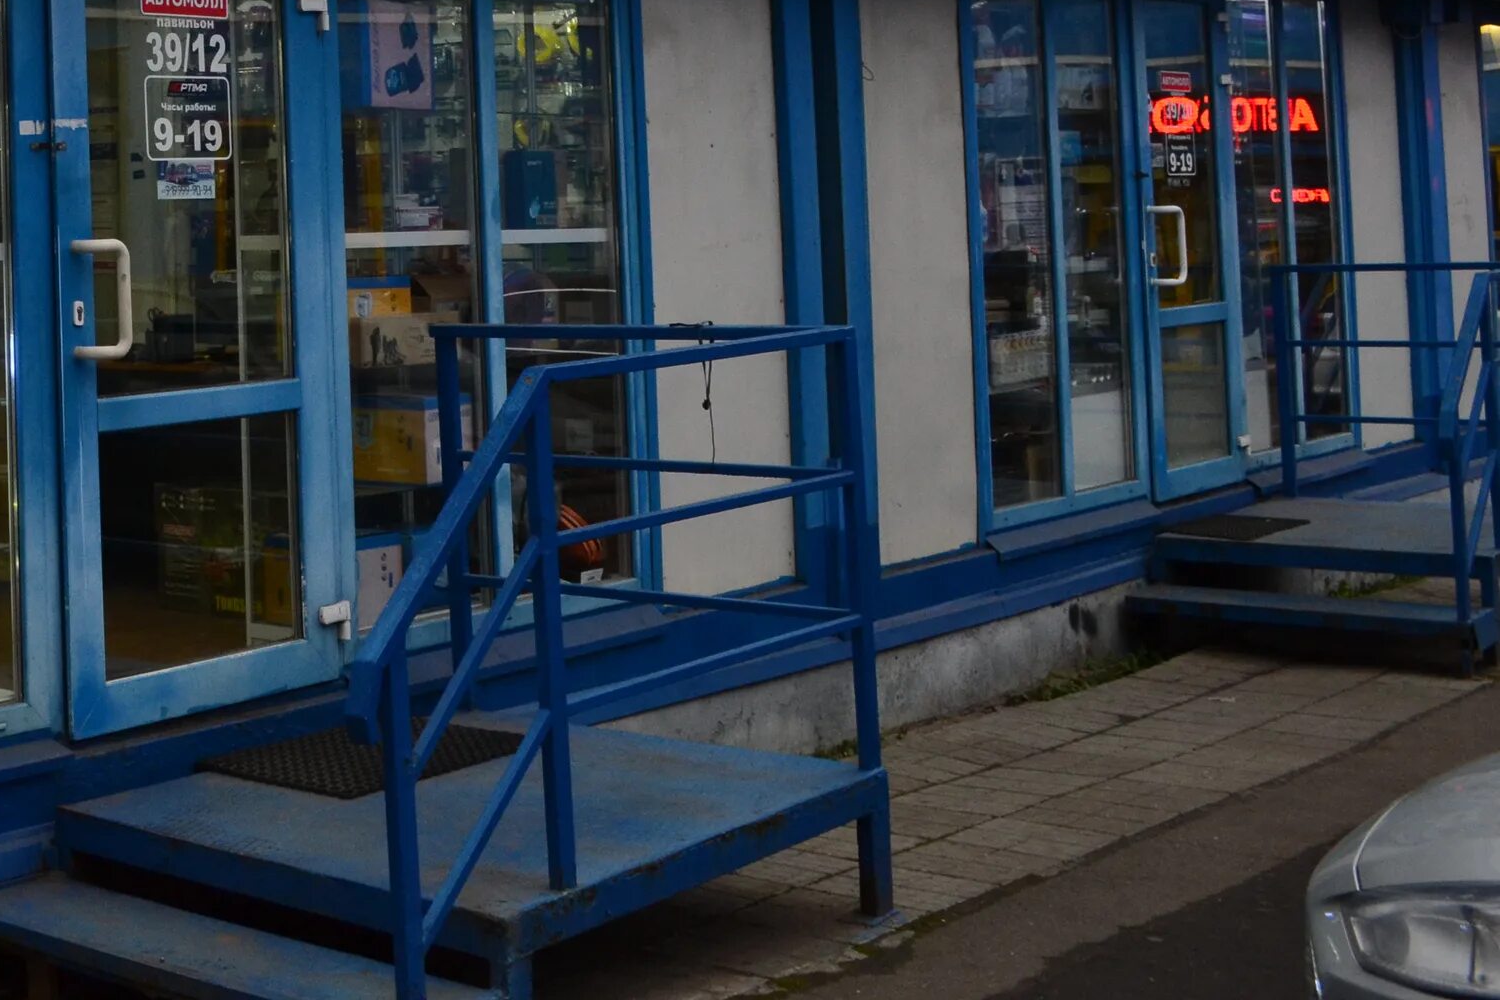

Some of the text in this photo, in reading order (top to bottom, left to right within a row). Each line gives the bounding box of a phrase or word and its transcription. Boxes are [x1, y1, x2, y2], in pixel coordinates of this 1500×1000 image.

[156, 16, 215, 30] павильон
[145, 31, 228, 73] 39/12
[160, 102, 184, 113] Часы
[153, 117, 223, 152] 9-19
[1169, 152, 1194, 172] 9-19
